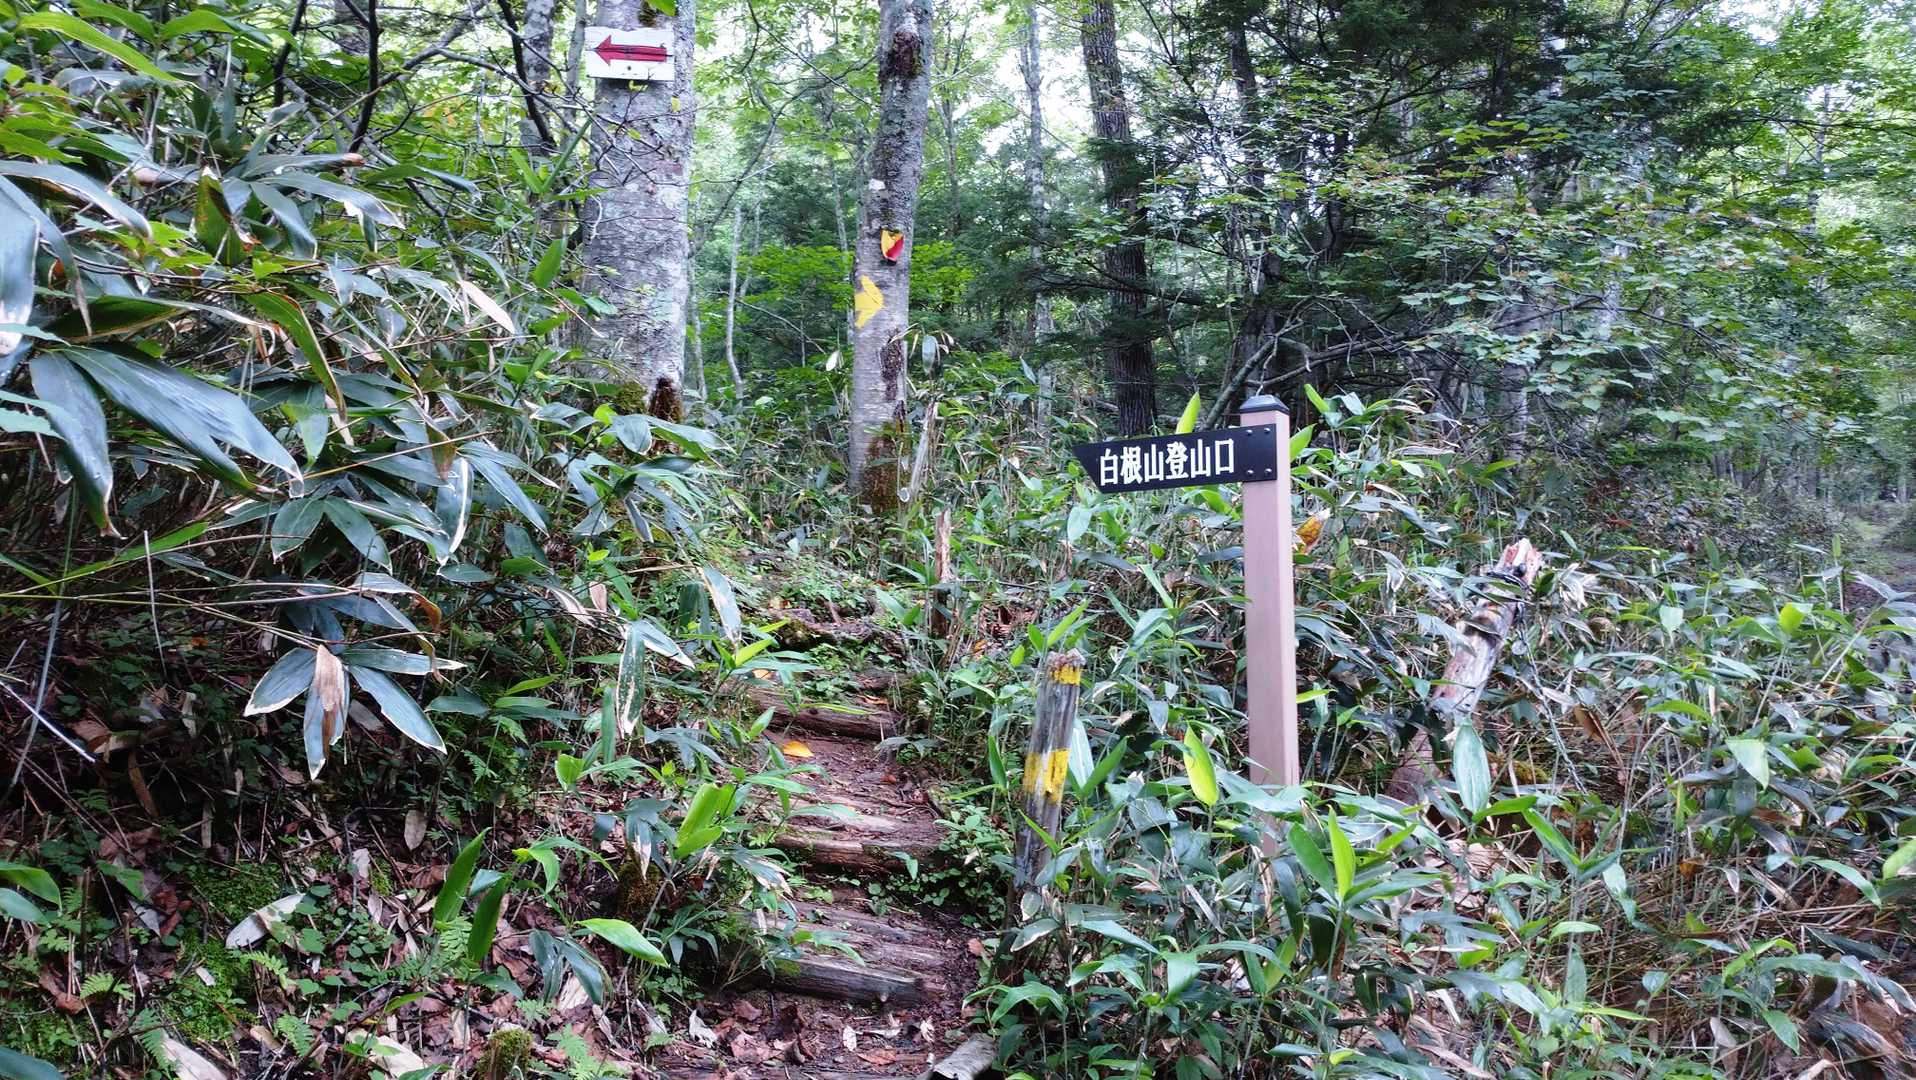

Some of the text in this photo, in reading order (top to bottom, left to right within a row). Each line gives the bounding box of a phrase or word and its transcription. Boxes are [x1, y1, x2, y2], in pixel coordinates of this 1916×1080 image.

[1100, 439, 1235, 486] 白根山登山口
